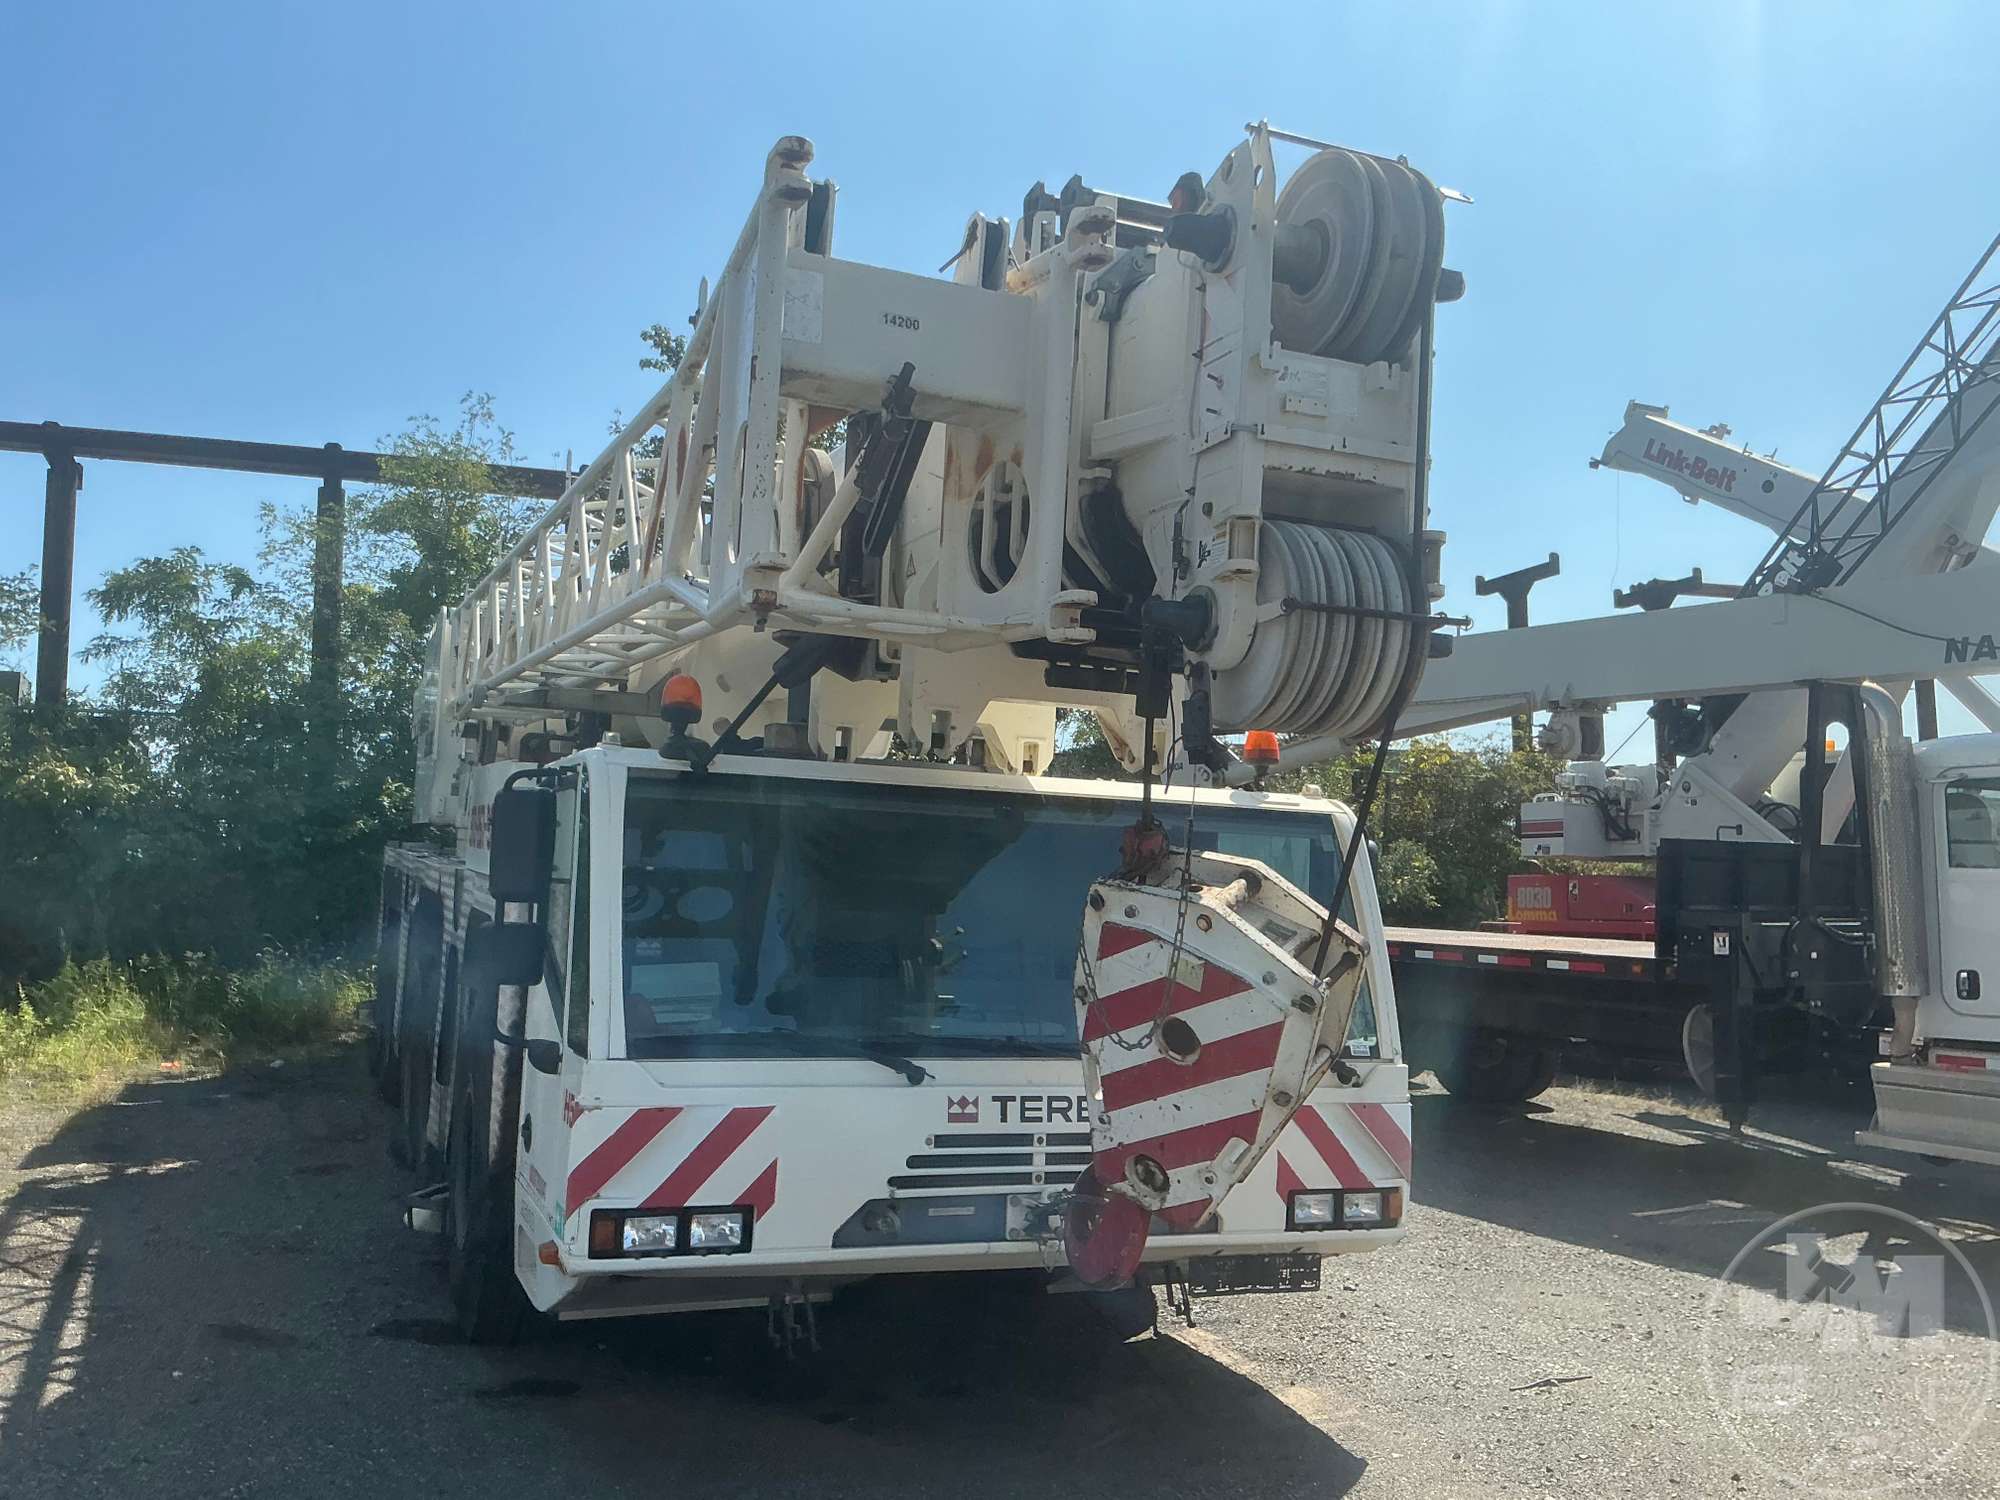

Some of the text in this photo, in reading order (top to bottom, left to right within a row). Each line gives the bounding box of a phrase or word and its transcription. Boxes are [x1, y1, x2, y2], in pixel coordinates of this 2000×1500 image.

[882, 312, 920, 330] 14200
[1643, 438, 1737, 493] Link-Belt
[1944, 634, 1998, 664] NA
